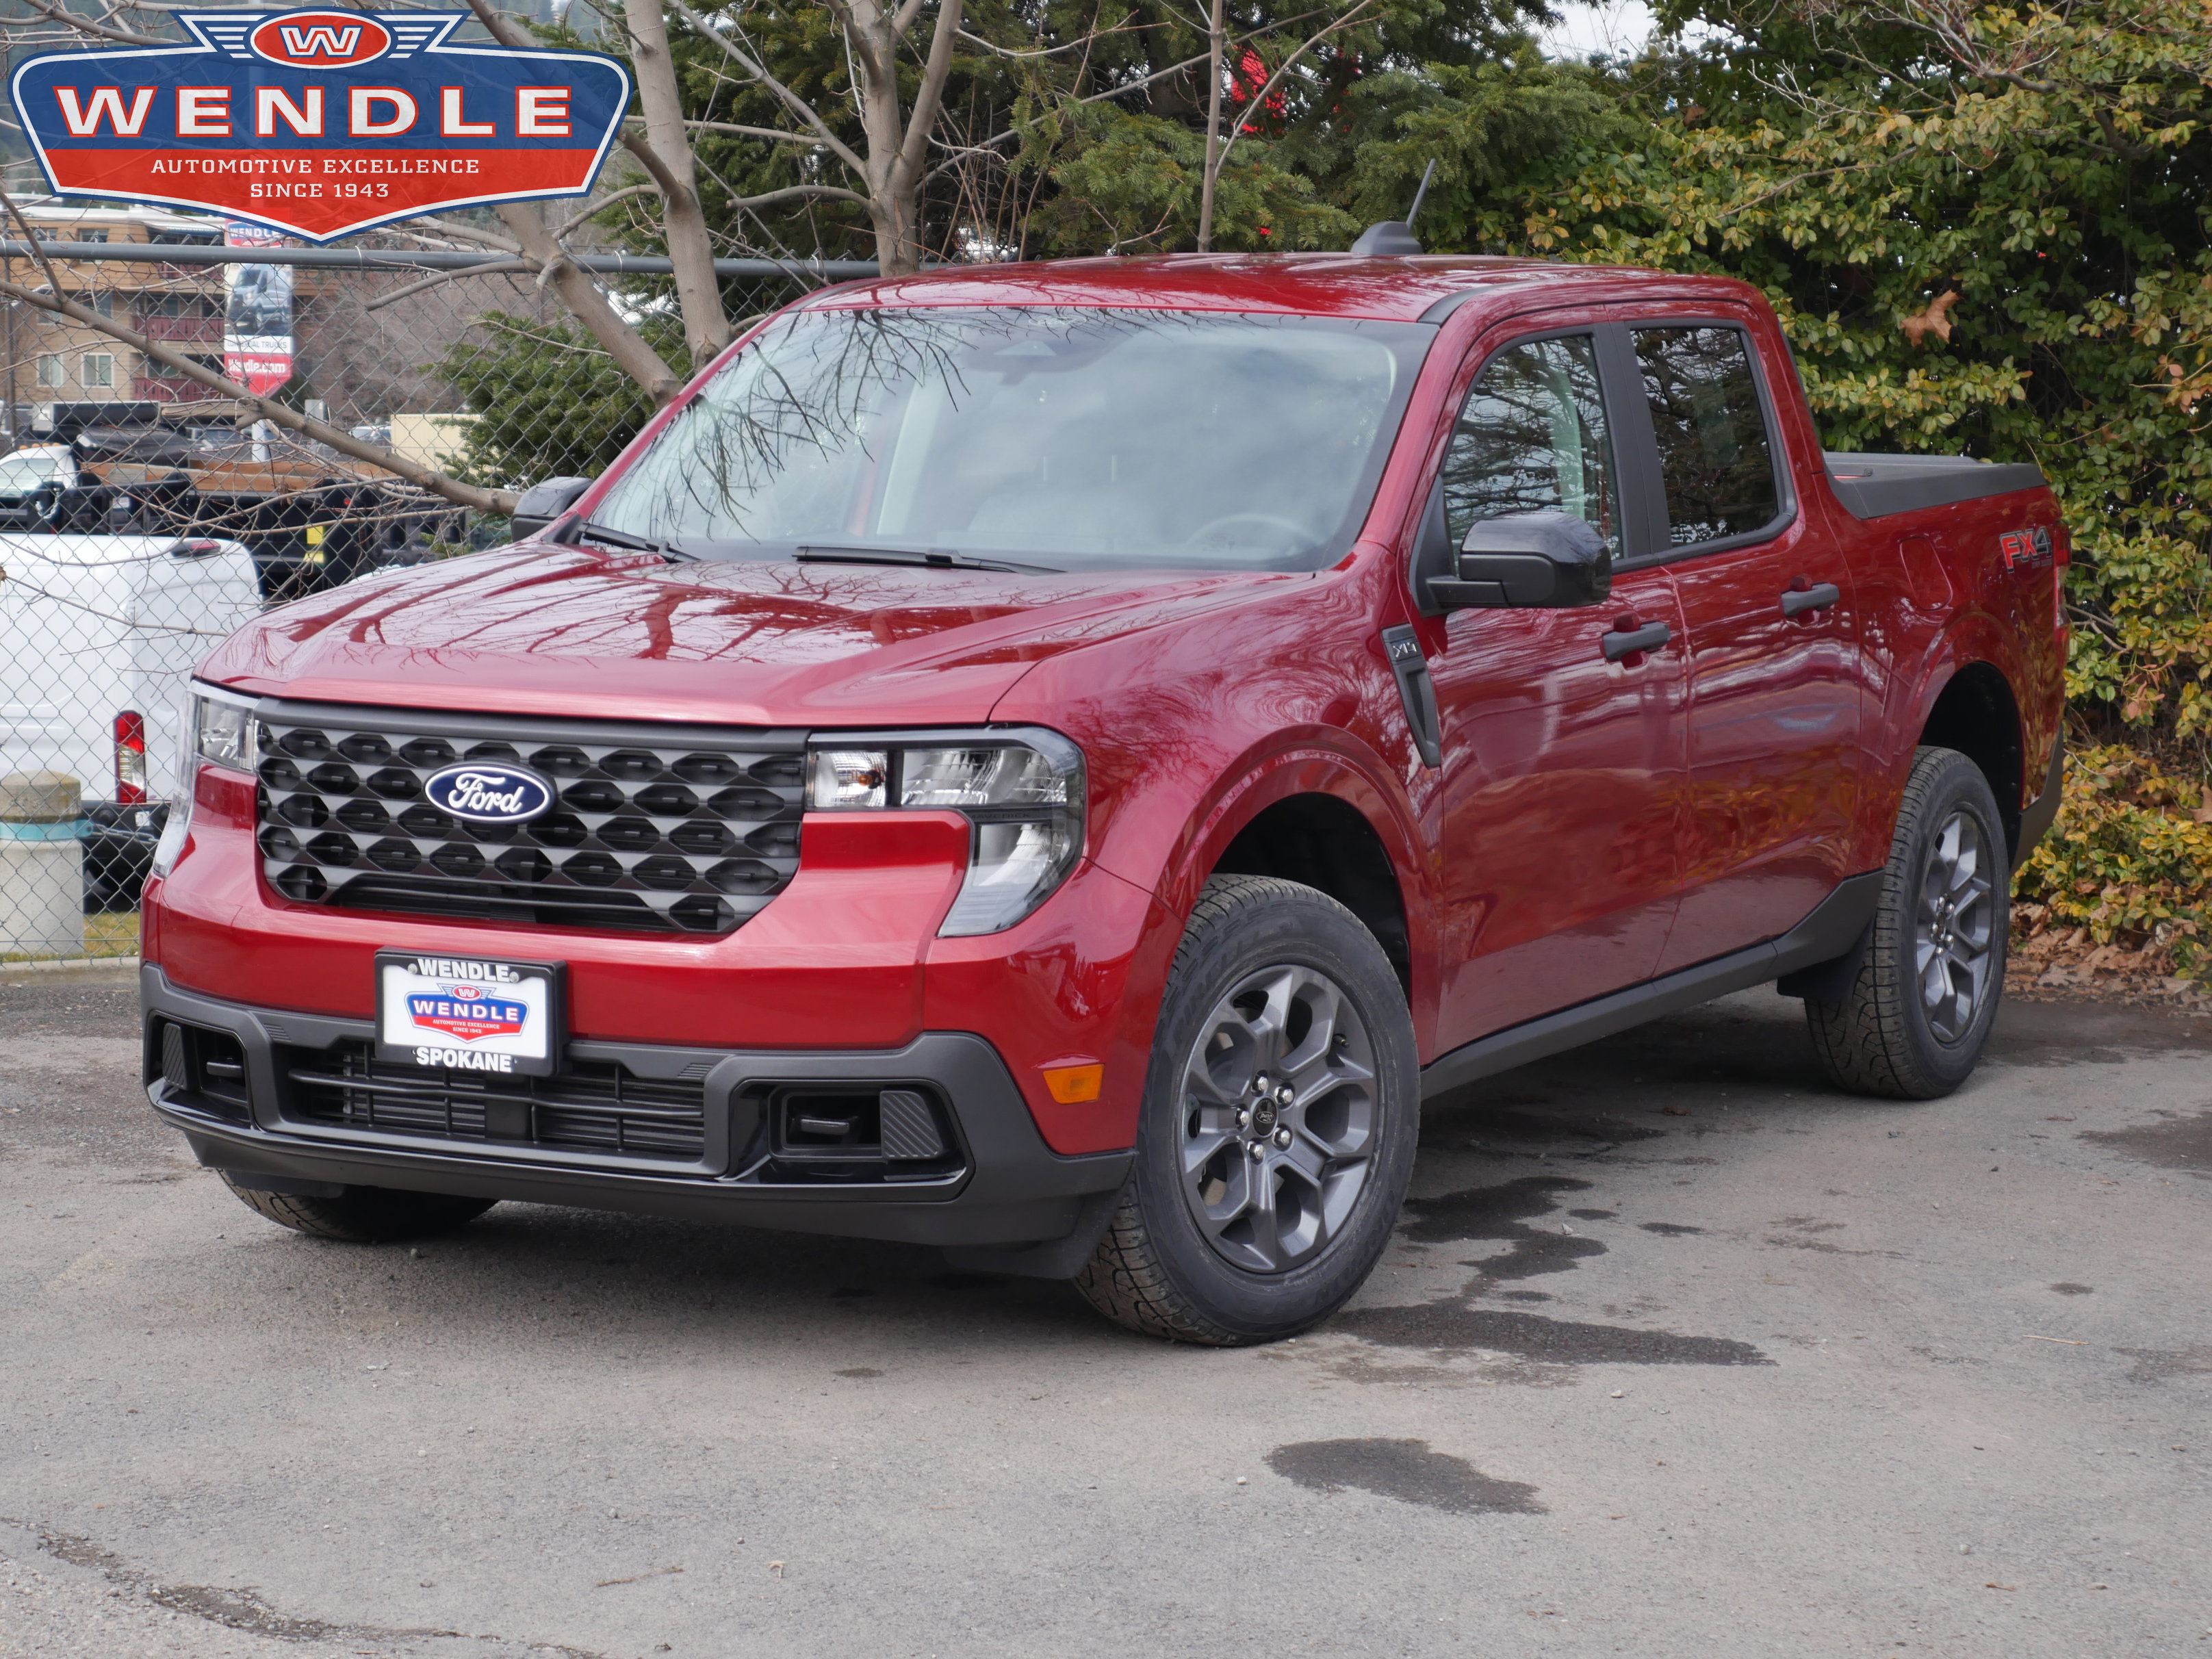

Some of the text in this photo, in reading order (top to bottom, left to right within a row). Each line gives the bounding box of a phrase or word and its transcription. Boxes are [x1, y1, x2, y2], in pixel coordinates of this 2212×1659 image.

[1999, 526, 2053, 574] FX4
[448, 773, 526, 813] Ford
[417, 958, 510, 983] WENDLE
[413, 1000, 519, 1022] WENDLE
[433, 1018, 466, 1027] AUTOMOTIVE
[416, 1046, 512, 1073] SPOKANE
